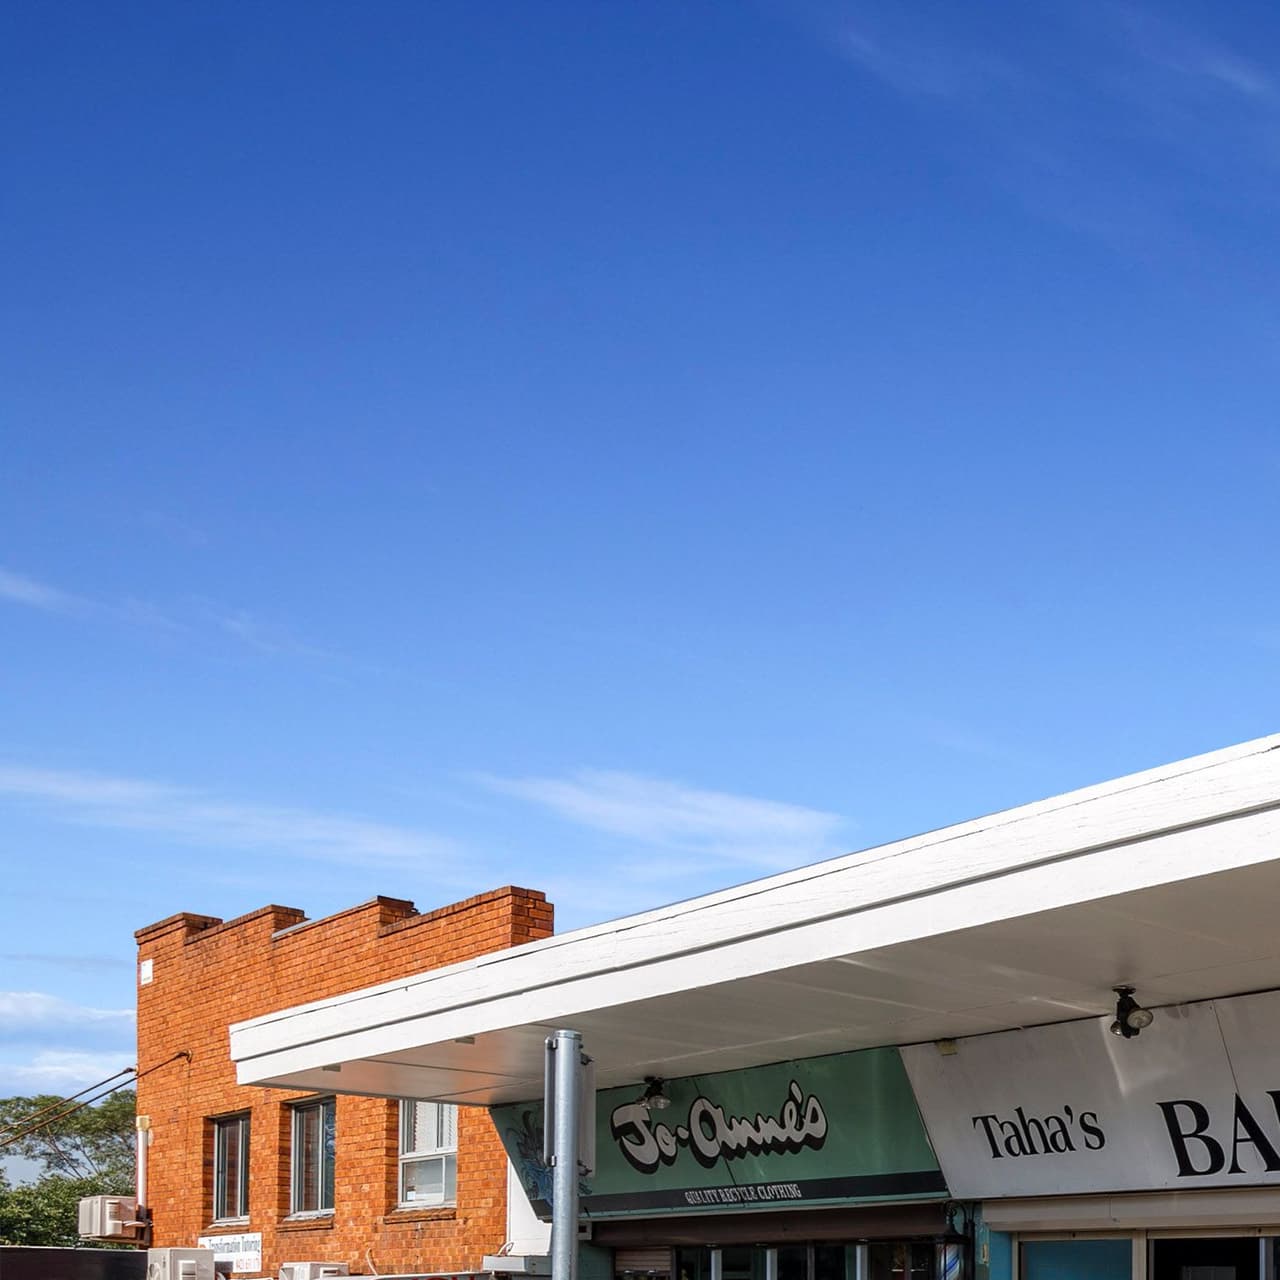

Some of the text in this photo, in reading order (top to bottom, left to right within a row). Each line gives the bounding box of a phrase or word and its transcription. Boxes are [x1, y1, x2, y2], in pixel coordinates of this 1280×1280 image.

[611, 1080, 827, 1170] Jo-Anne's
[972, 1105, 1105, 1158] Taha's
[758, 1183, 802, 1200] CLOTHING
